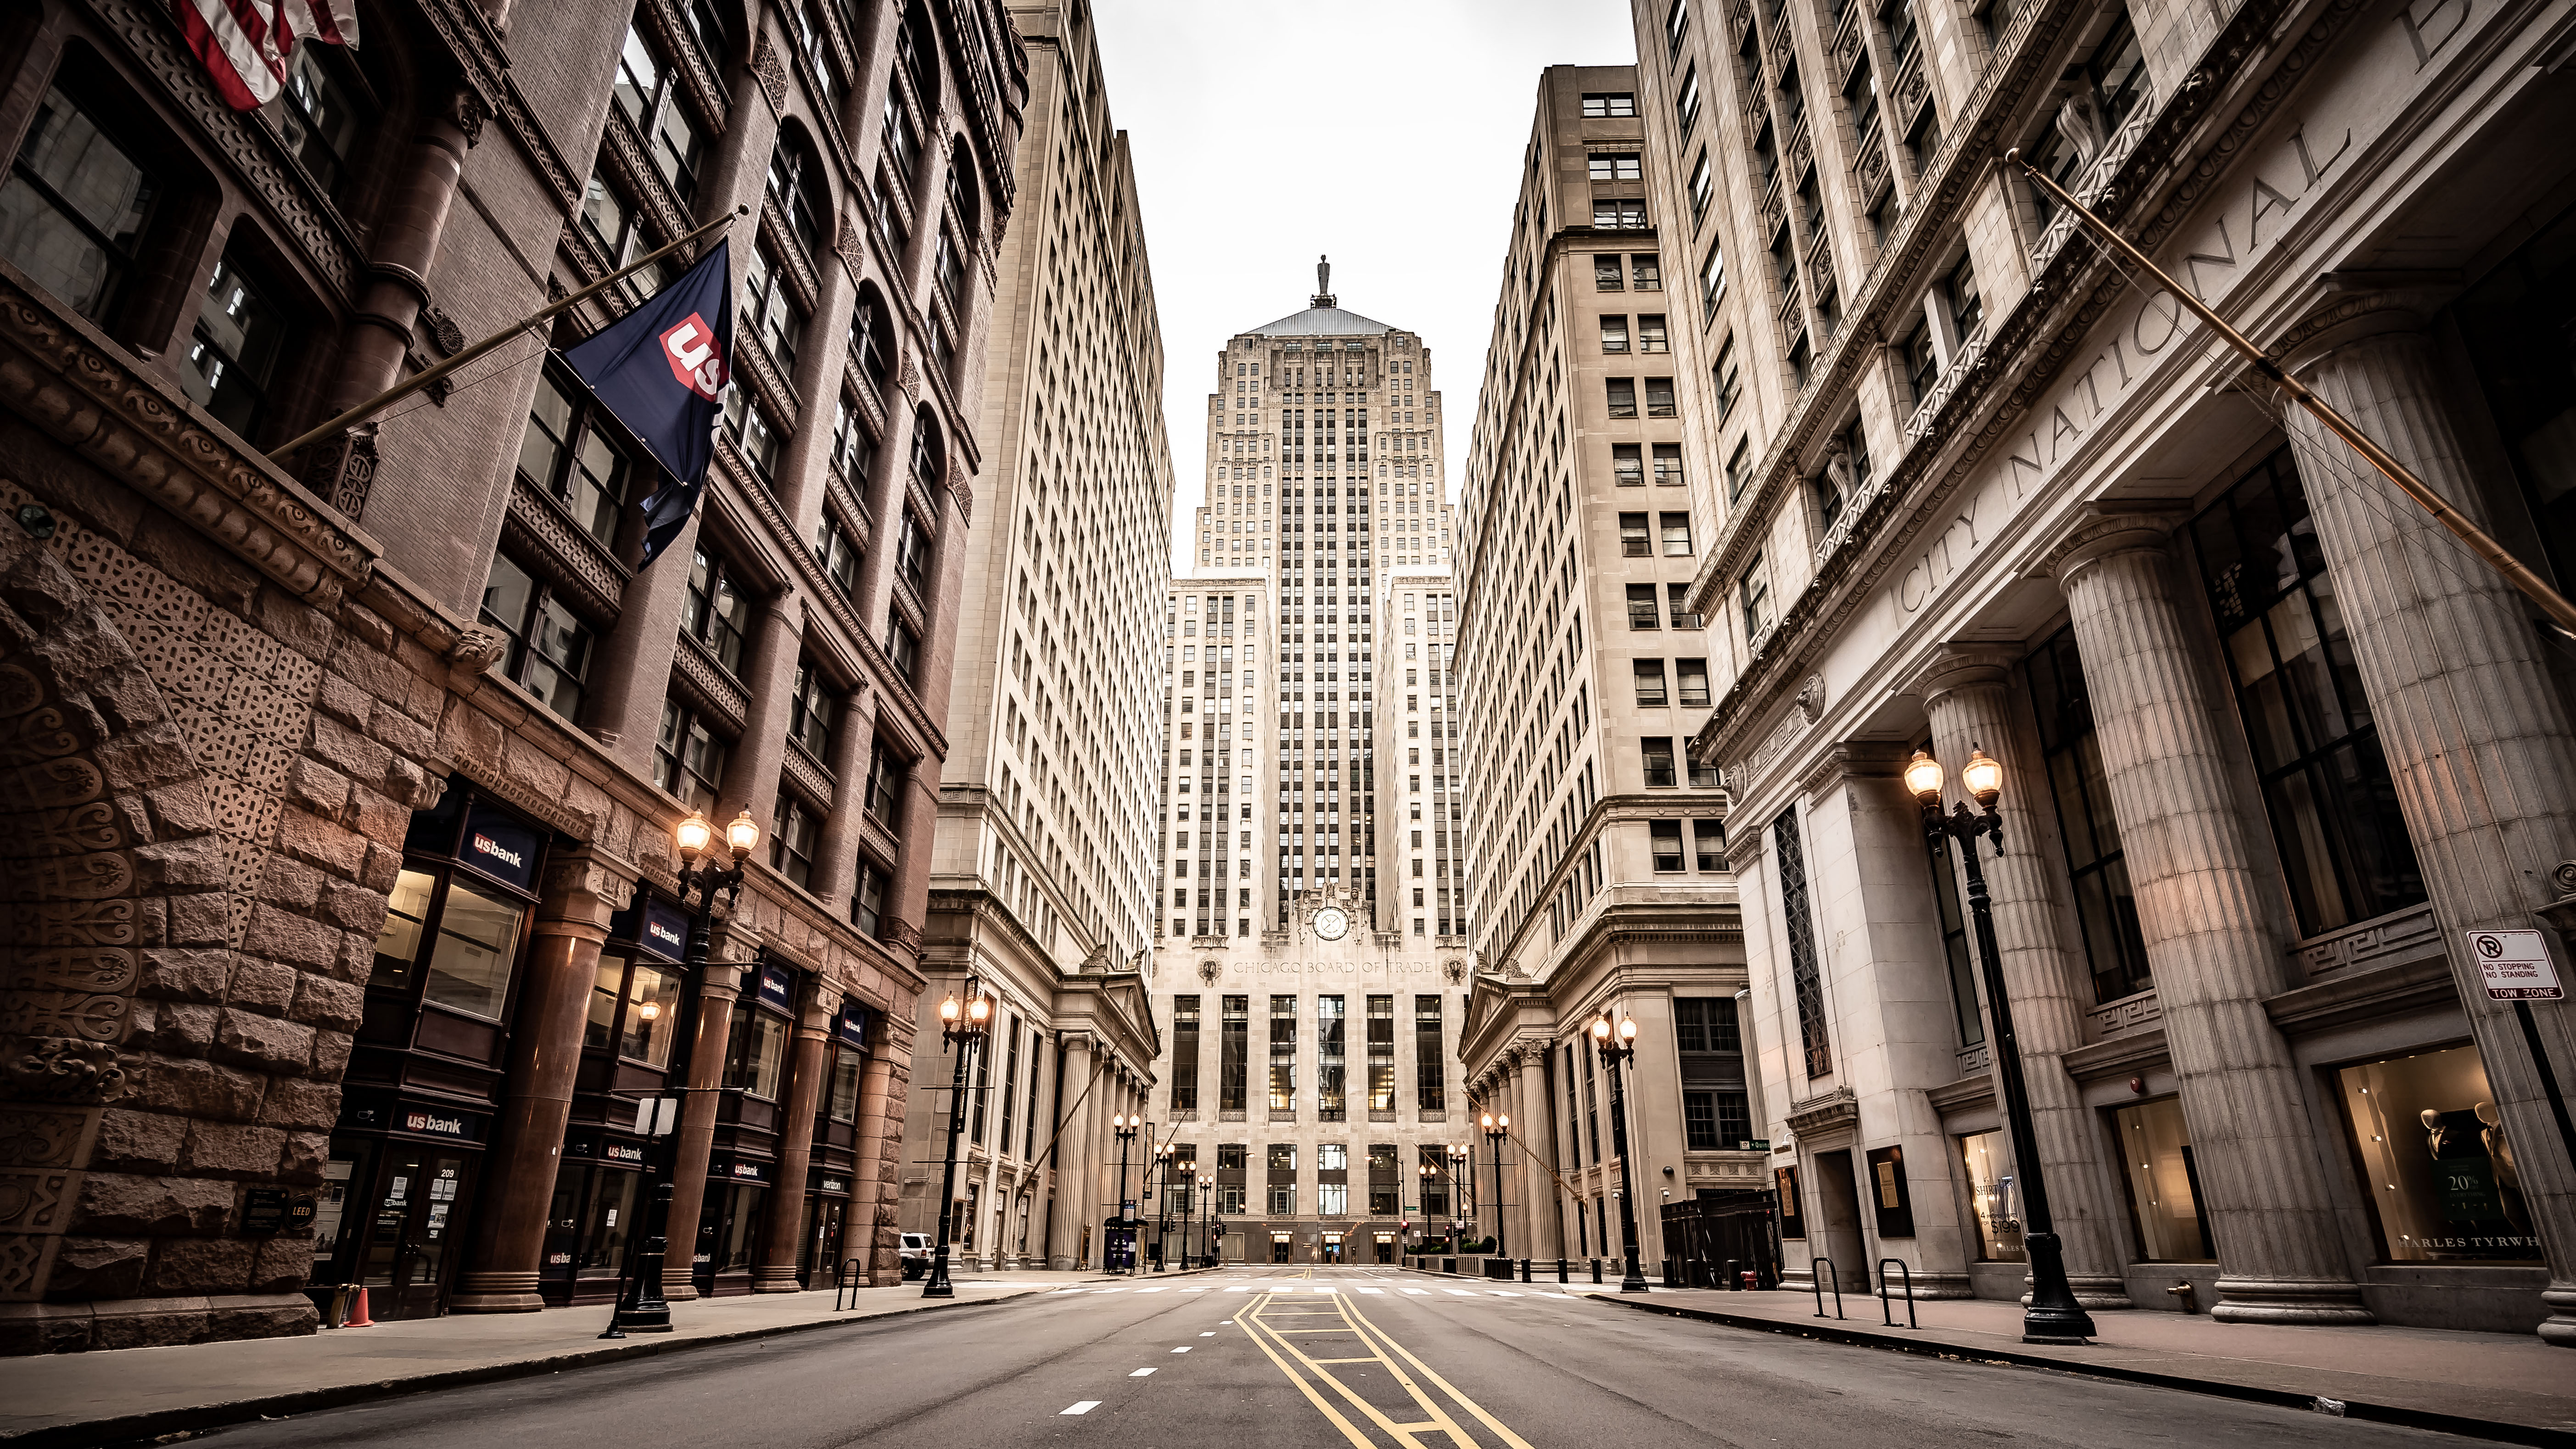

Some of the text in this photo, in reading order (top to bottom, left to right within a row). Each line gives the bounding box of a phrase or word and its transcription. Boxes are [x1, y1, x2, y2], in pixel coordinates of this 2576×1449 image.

[1900, 492, 1980, 613] CITY
[2009, 127, 2351, 500] NATIONAL
[1234, 962, 1432, 973] CHICAGO BOARD OF TRADE
[2492, 989, 2556, 998] TOW ZONE
[441, 1169, 454, 1177] 209
[823, 1179, 840, 1190] verizon
[1976, 1184, 1998, 1196] SHIRT
[293, 1207, 310, 1216] LEED
[1991, 1219, 2020, 1236] $199
